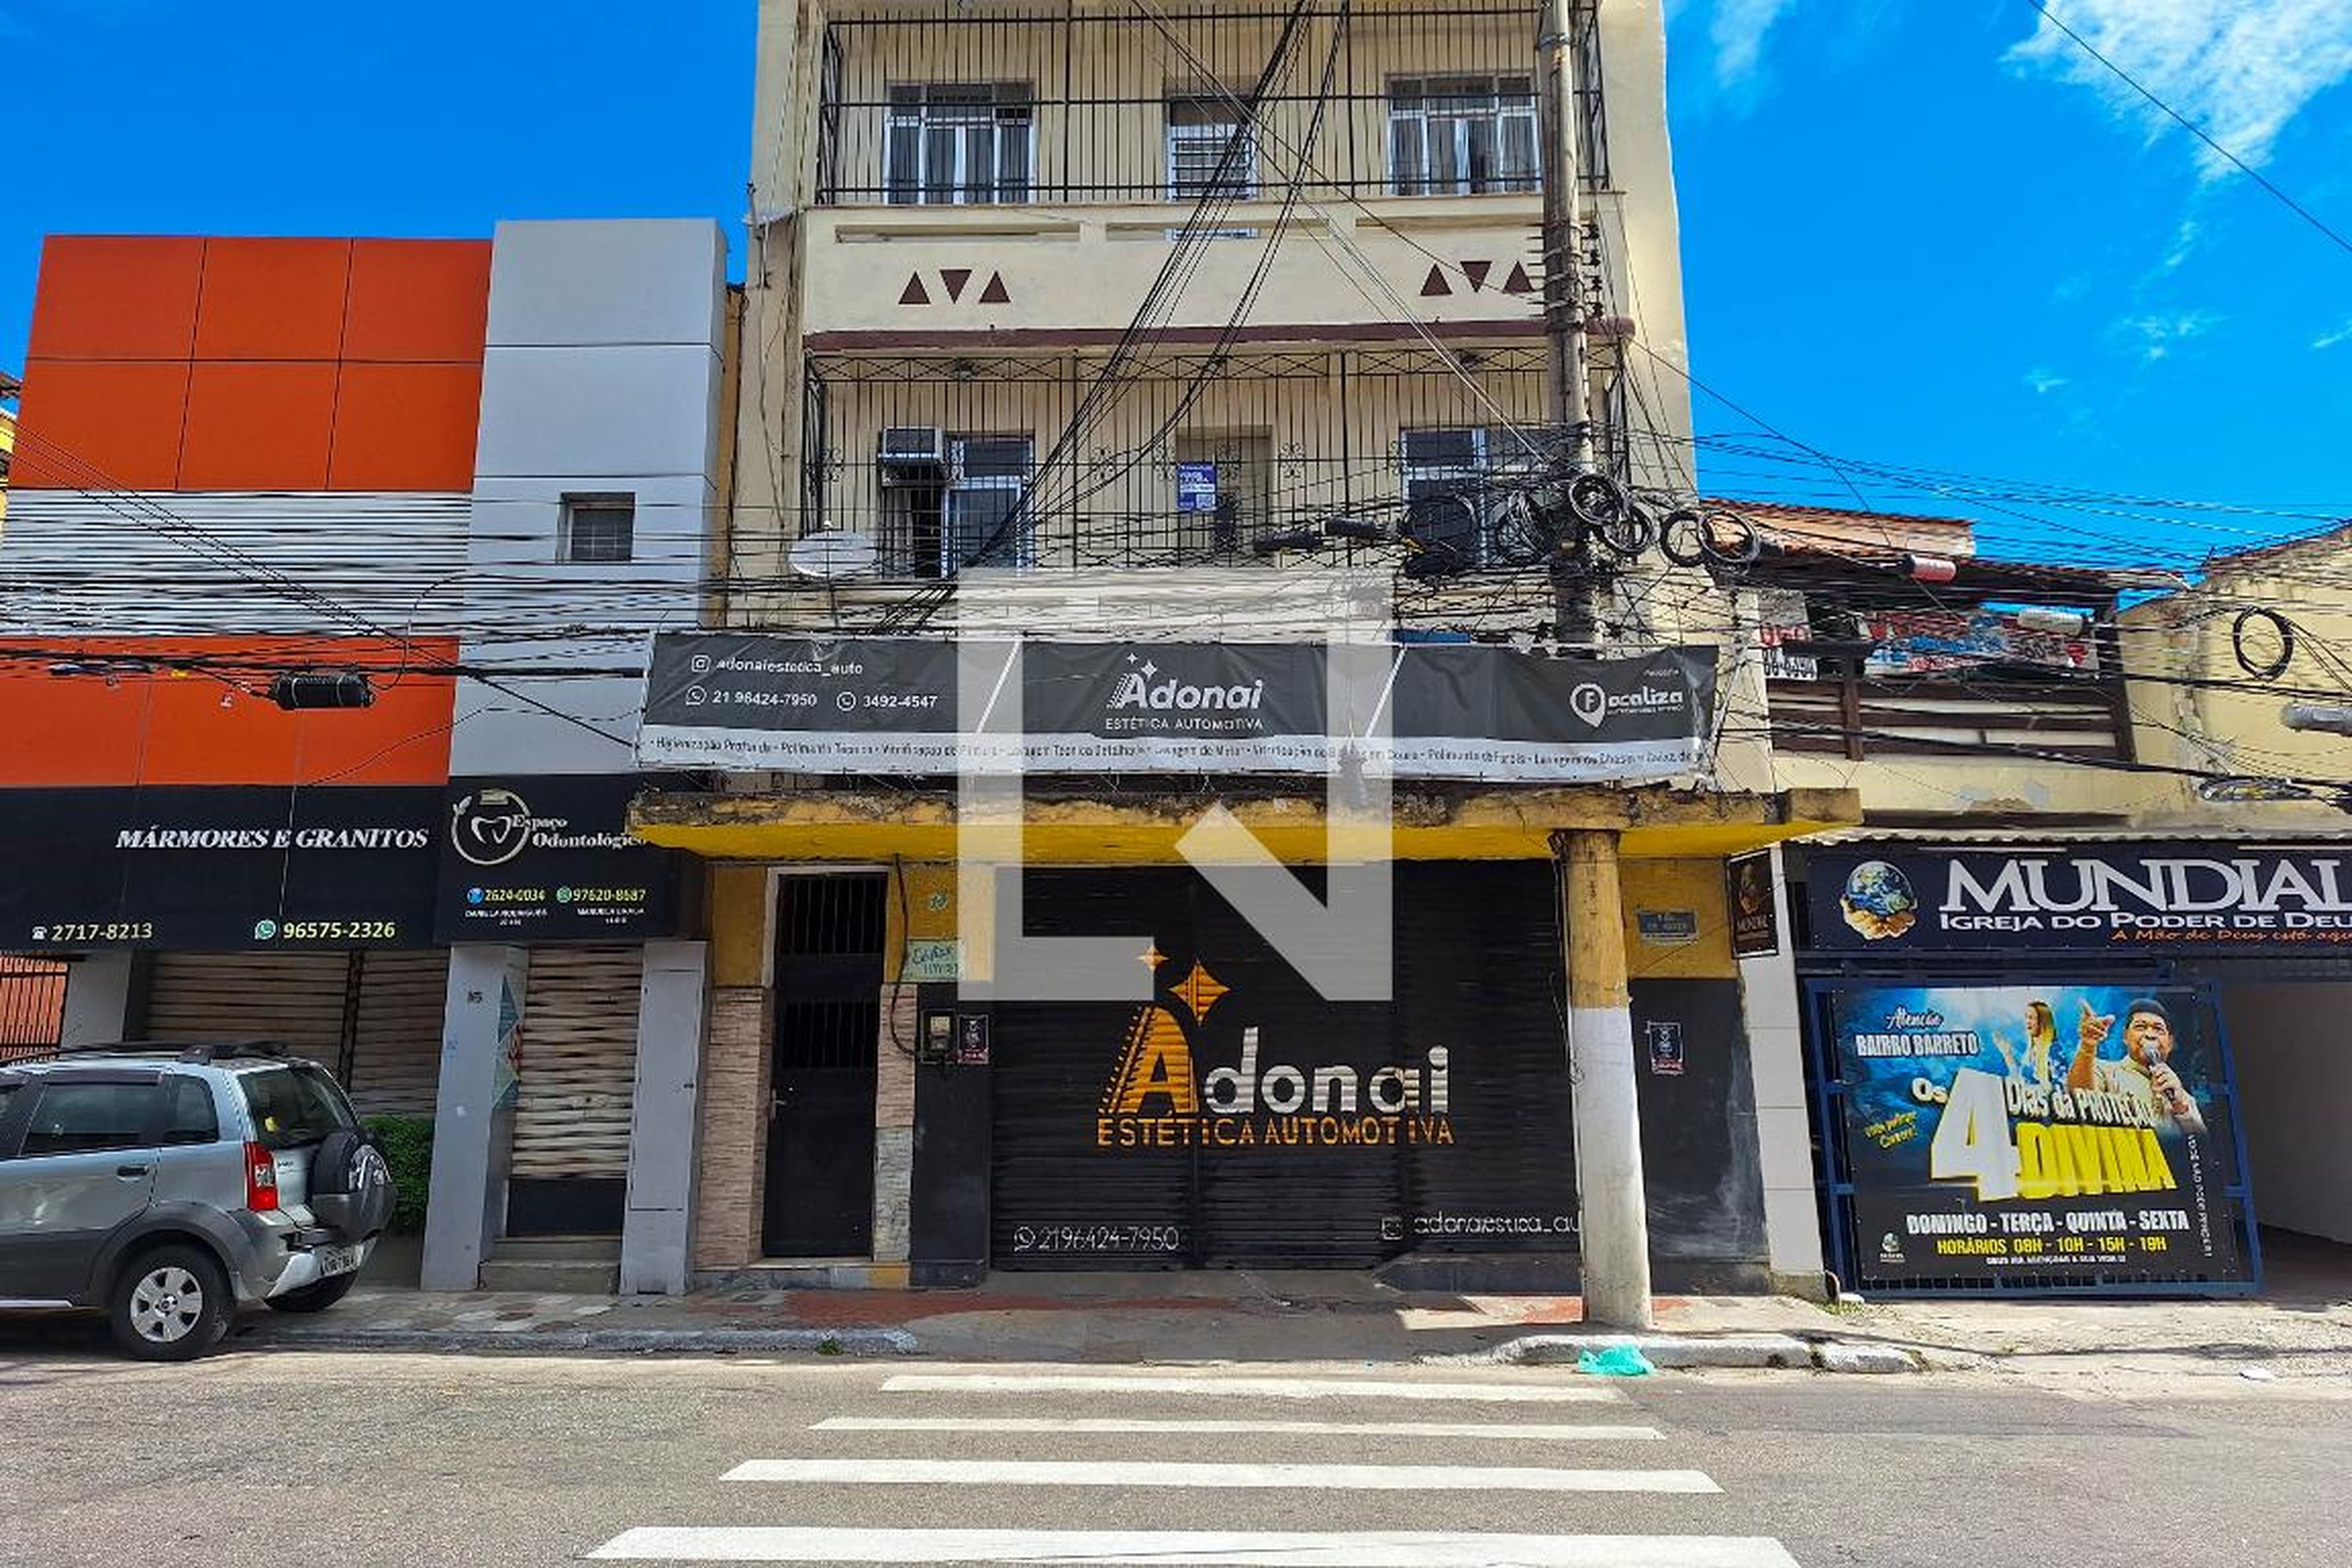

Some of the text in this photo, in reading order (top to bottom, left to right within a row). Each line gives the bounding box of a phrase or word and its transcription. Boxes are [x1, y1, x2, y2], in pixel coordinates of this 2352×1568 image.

[712, 690, 730, 704] 21
[863, 695, 938, 709] 3492-4547
[1106, 673, 1264, 710] Adonai
[1105, 715, 1264, 731] ESTÉTICA AUTOMOTIVA
[115, 824, 428, 848] MÁRMORES E GRANITOS
[1939, 858, 2352, 913] MUNDIAL
[51, 922, 153, 941] 2717-8213
[284, 922, 396, 939] 96575-2326
[1940, 912, 2043, 932] IGREJA
[2051, 915, 2101, 929] DO
[2110, 912, 2226, 929] PODER
[2234, 915, 2277, 928] DE
[2111, 929, 2128, 940] A
[1855, 1030, 1979, 1057] BAIRRO BARRETO
[1098, 1005, 1449, 1114] Adonai
[1264, 1116, 1455, 1146] AUTOMOTIVA
[1931, 1066, 2019, 1201] 4
[2016, 1121, 2177, 1199] DIVINA
[1906, 1210, 2190, 1235] DOMINGO TERÇA QUINTA SEXTA
[1937, 1237, 2007, 1255] HORÁRIOS
[2056, 1236, 2084, 1253] 10H
[2097, 1235, 2126, 1251] 15H
[2139, 1235, 2167, 1251] 19H
